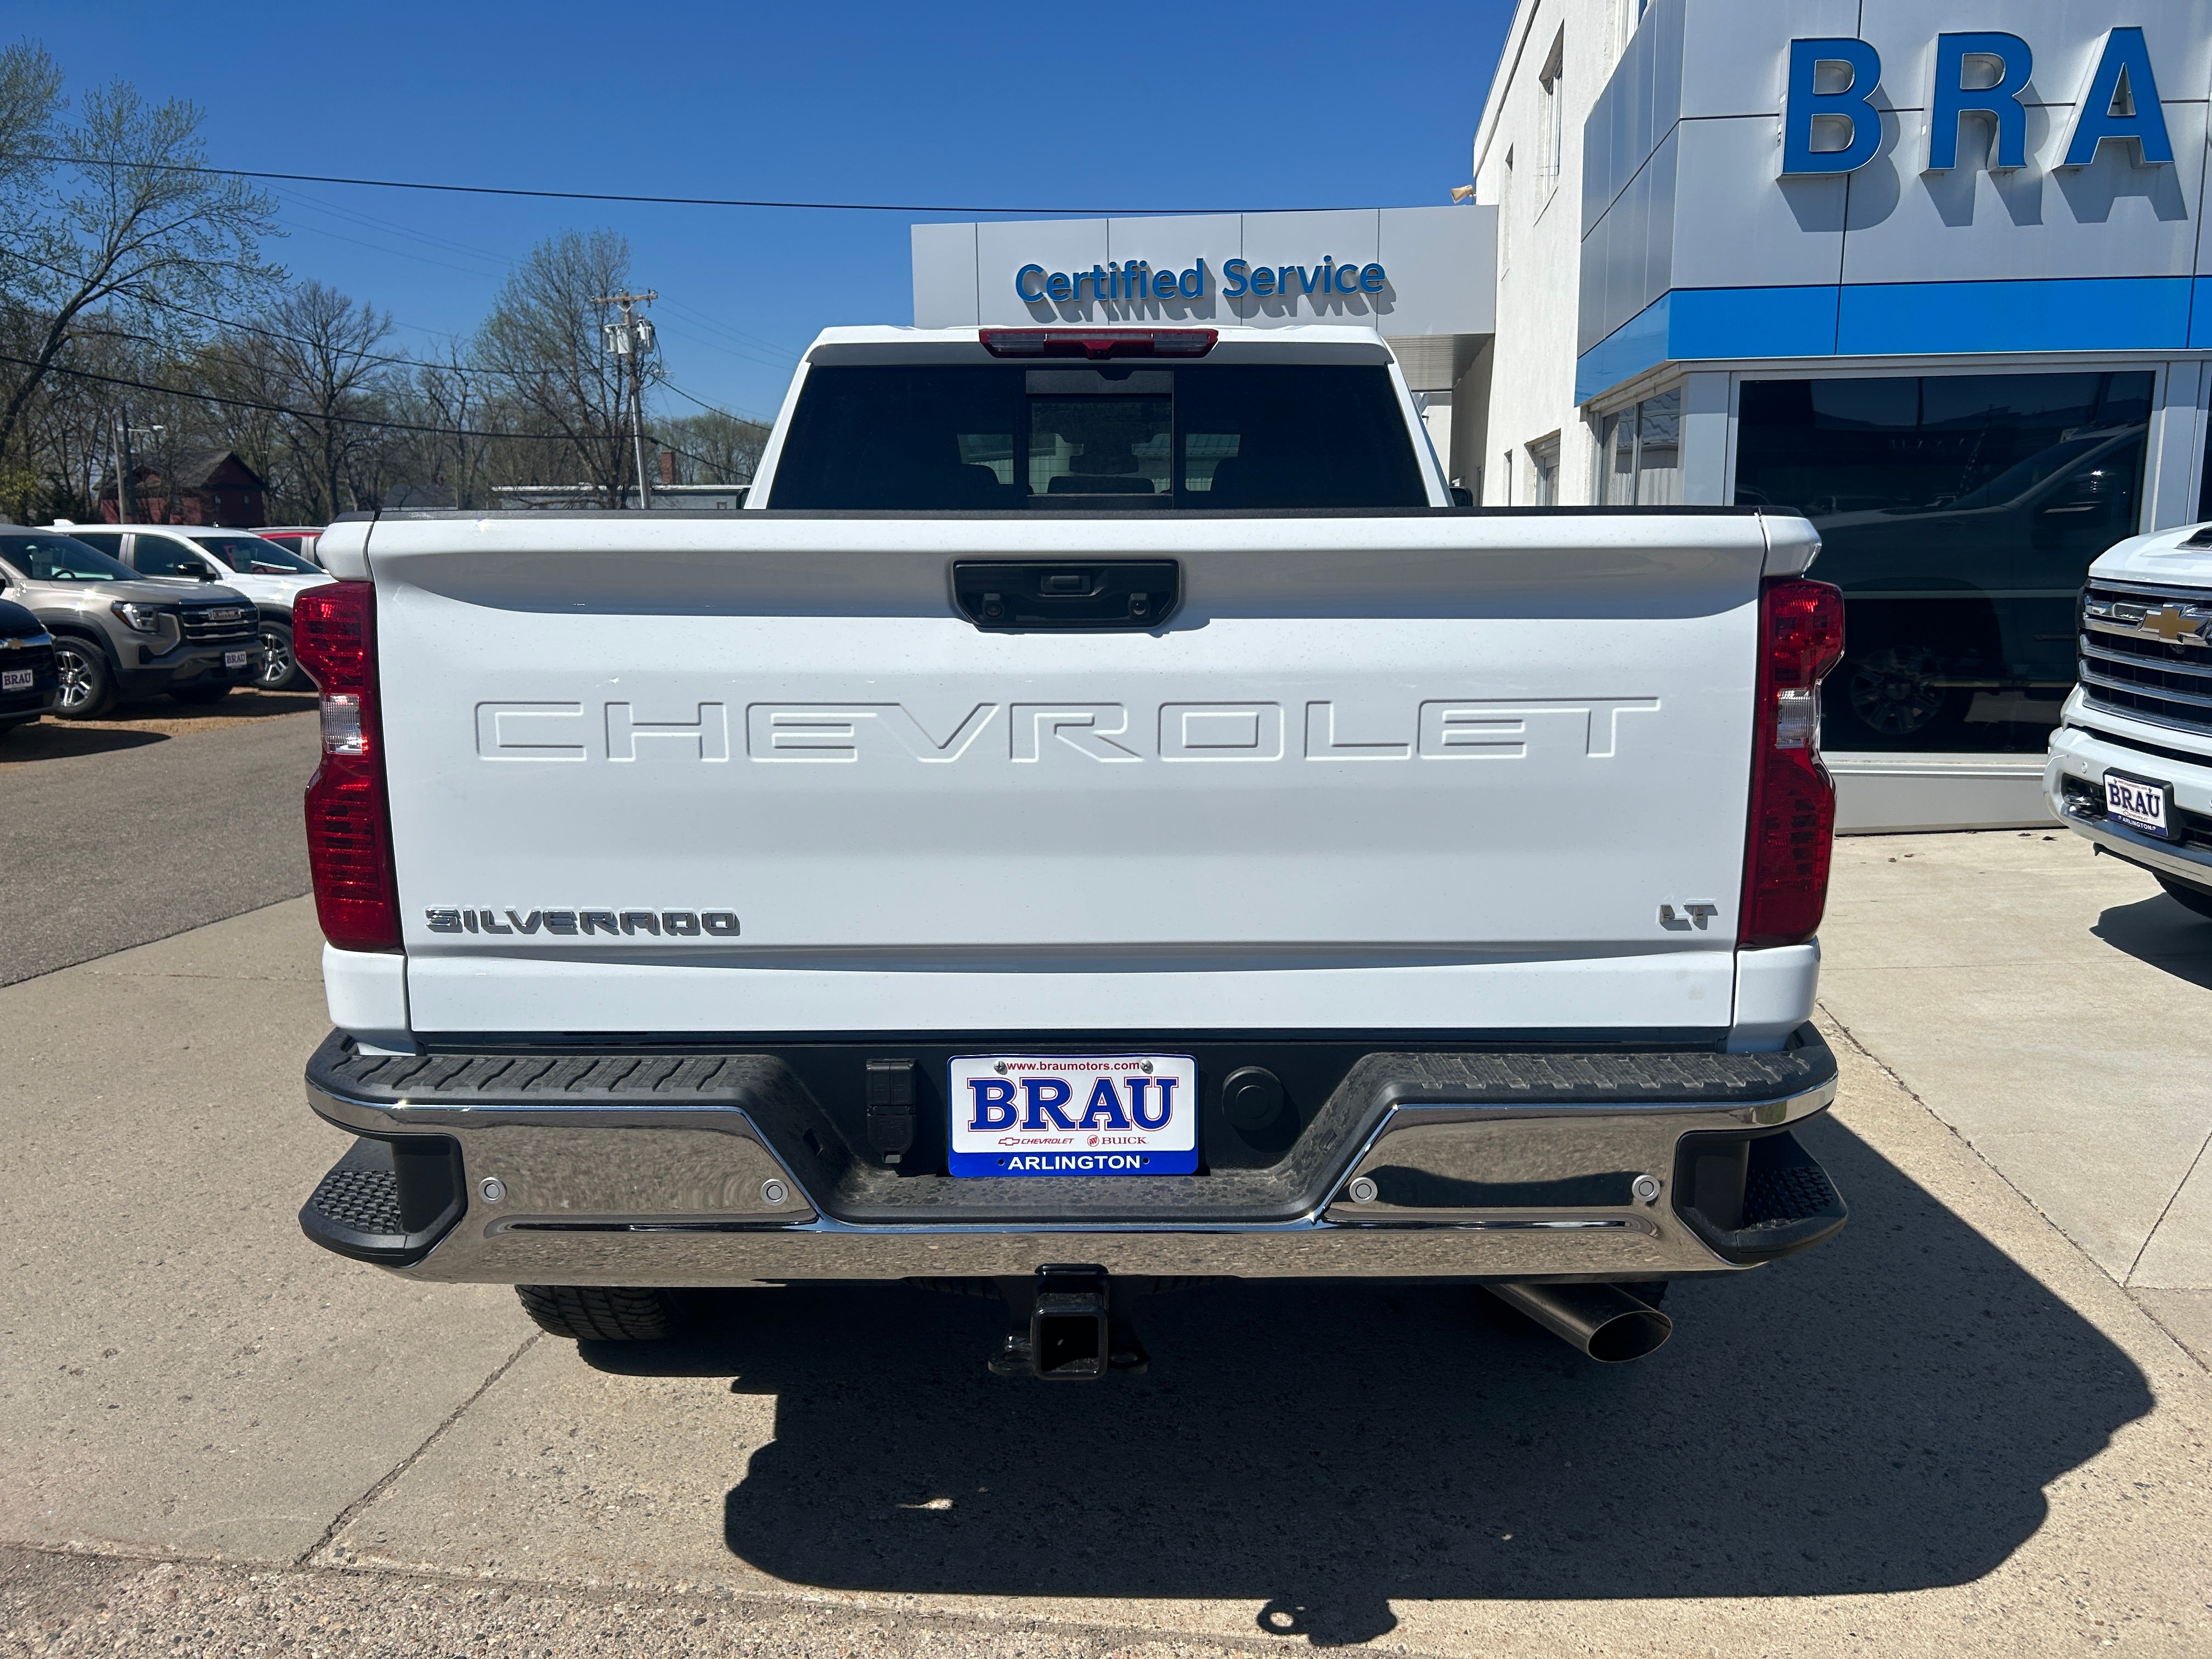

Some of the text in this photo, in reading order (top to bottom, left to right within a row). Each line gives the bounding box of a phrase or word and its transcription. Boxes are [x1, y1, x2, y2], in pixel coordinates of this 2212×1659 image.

[1015, 255, 1385, 302] Certified Service
[227, 654, 245, 664] BRAU
[4, 673, 31, 685] BRAU
[475, 697, 1661, 763] CHEVROLET
[2108, 782, 2160, 819] BRAU
[2122, 817, 2152, 831] ARLINGTON
[425, 906, 738, 936] SILVERADO
[1658, 900, 1718, 931] LT
[1006, 1060, 1140, 1071] www.braumotors.com
[967, 1076, 1180, 1132] BRAU
[1101, 1136, 1148, 1144] BUICK
[1007, 1155, 1140, 1170] ARLINGTON
